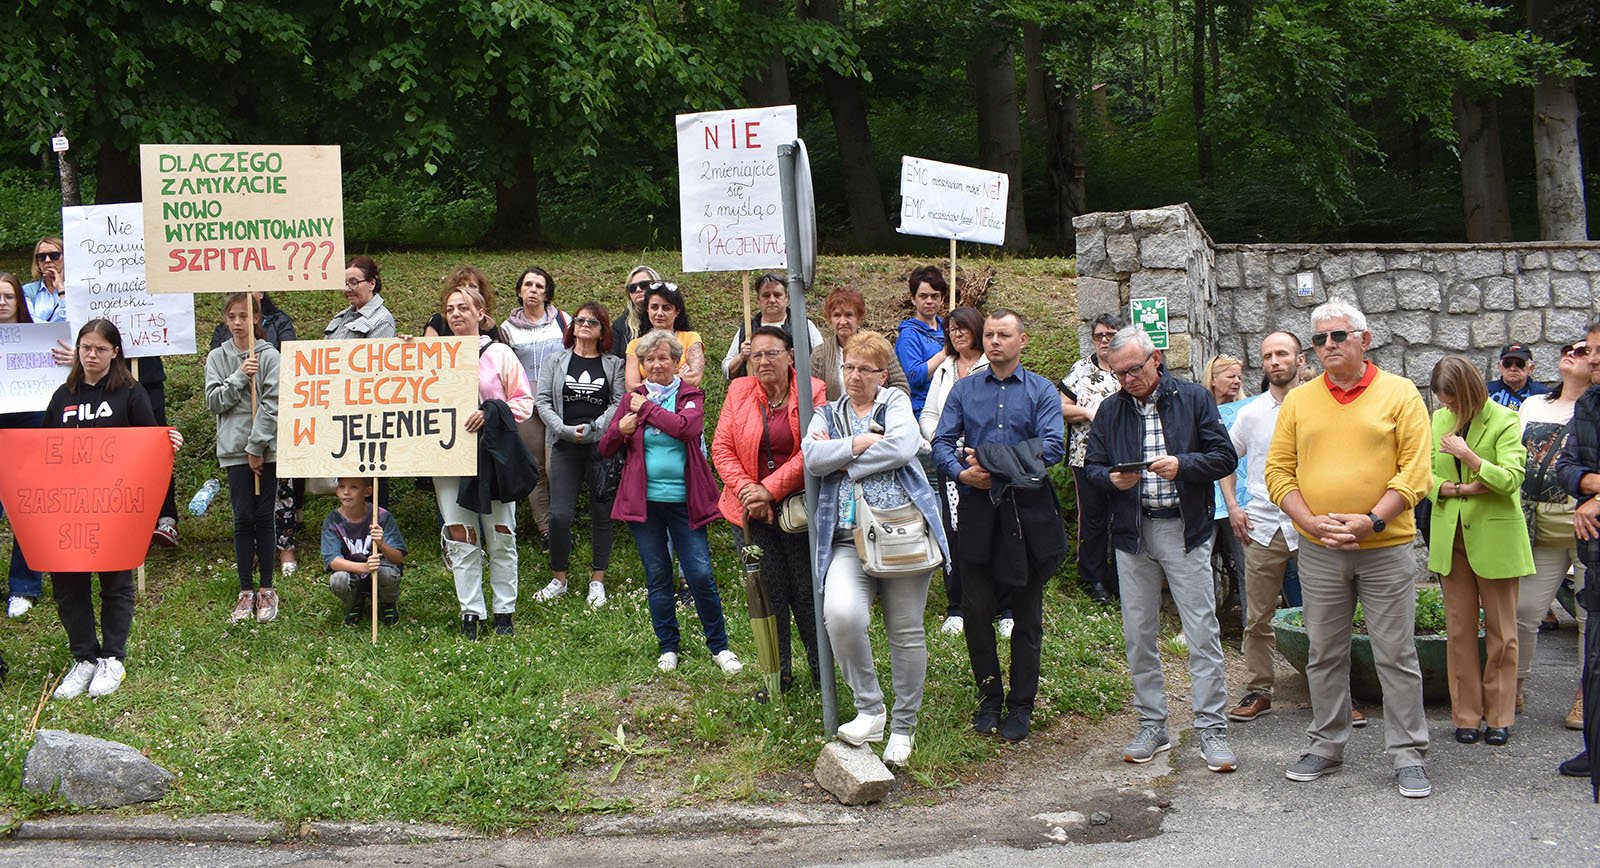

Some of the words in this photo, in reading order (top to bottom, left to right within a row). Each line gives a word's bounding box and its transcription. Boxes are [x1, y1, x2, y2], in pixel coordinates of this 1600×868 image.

[705, 118, 762, 150] NIE
[159, 151, 283, 174] DLACZEGO
[160, 176, 288, 196] ZAMYKACIE
[906, 163, 929, 187] EMC
[162, 199, 223, 220] NOWO
[766, 203, 777, 216] o
[904, 195, 926, 219] EMC
[107, 214, 133, 236] Nie
[164, 217, 335, 243] WYREMONTOWANY
[80, 237, 145, 255] Rozumi
[699, 223, 787, 256] PACJENTAC
[93, 257, 115, 276] po
[117, 252, 146, 274] pols
[168, 246, 276, 273] SZPITAL
[282, 240, 336, 281] ???
[80, 277, 102, 295] To
[130, 312, 146, 329] IT
[147, 312, 167, 328] AS
[129, 327, 169, 346] WAS!
[6, 351, 62, 371] EKONOMI
[295, 346, 341, 377] NIE
[348, 341, 462, 373] CHCEMY
[293, 379, 330, 410] SIĘ
[344, 369, 440, 405] LECZYĆ
[562, 393, 604, 406] adidas
[62, 400, 114, 424] FILA
[293, 417, 317, 447] W
[331, 408, 457, 459] JELENIEJ
[45, 436, 117, 465] EMC
[358, 441, 388, 473] !!!
[17, 478, 145, 515] ZASTANÓW
[58, 522, 101, 555] SIĘ
